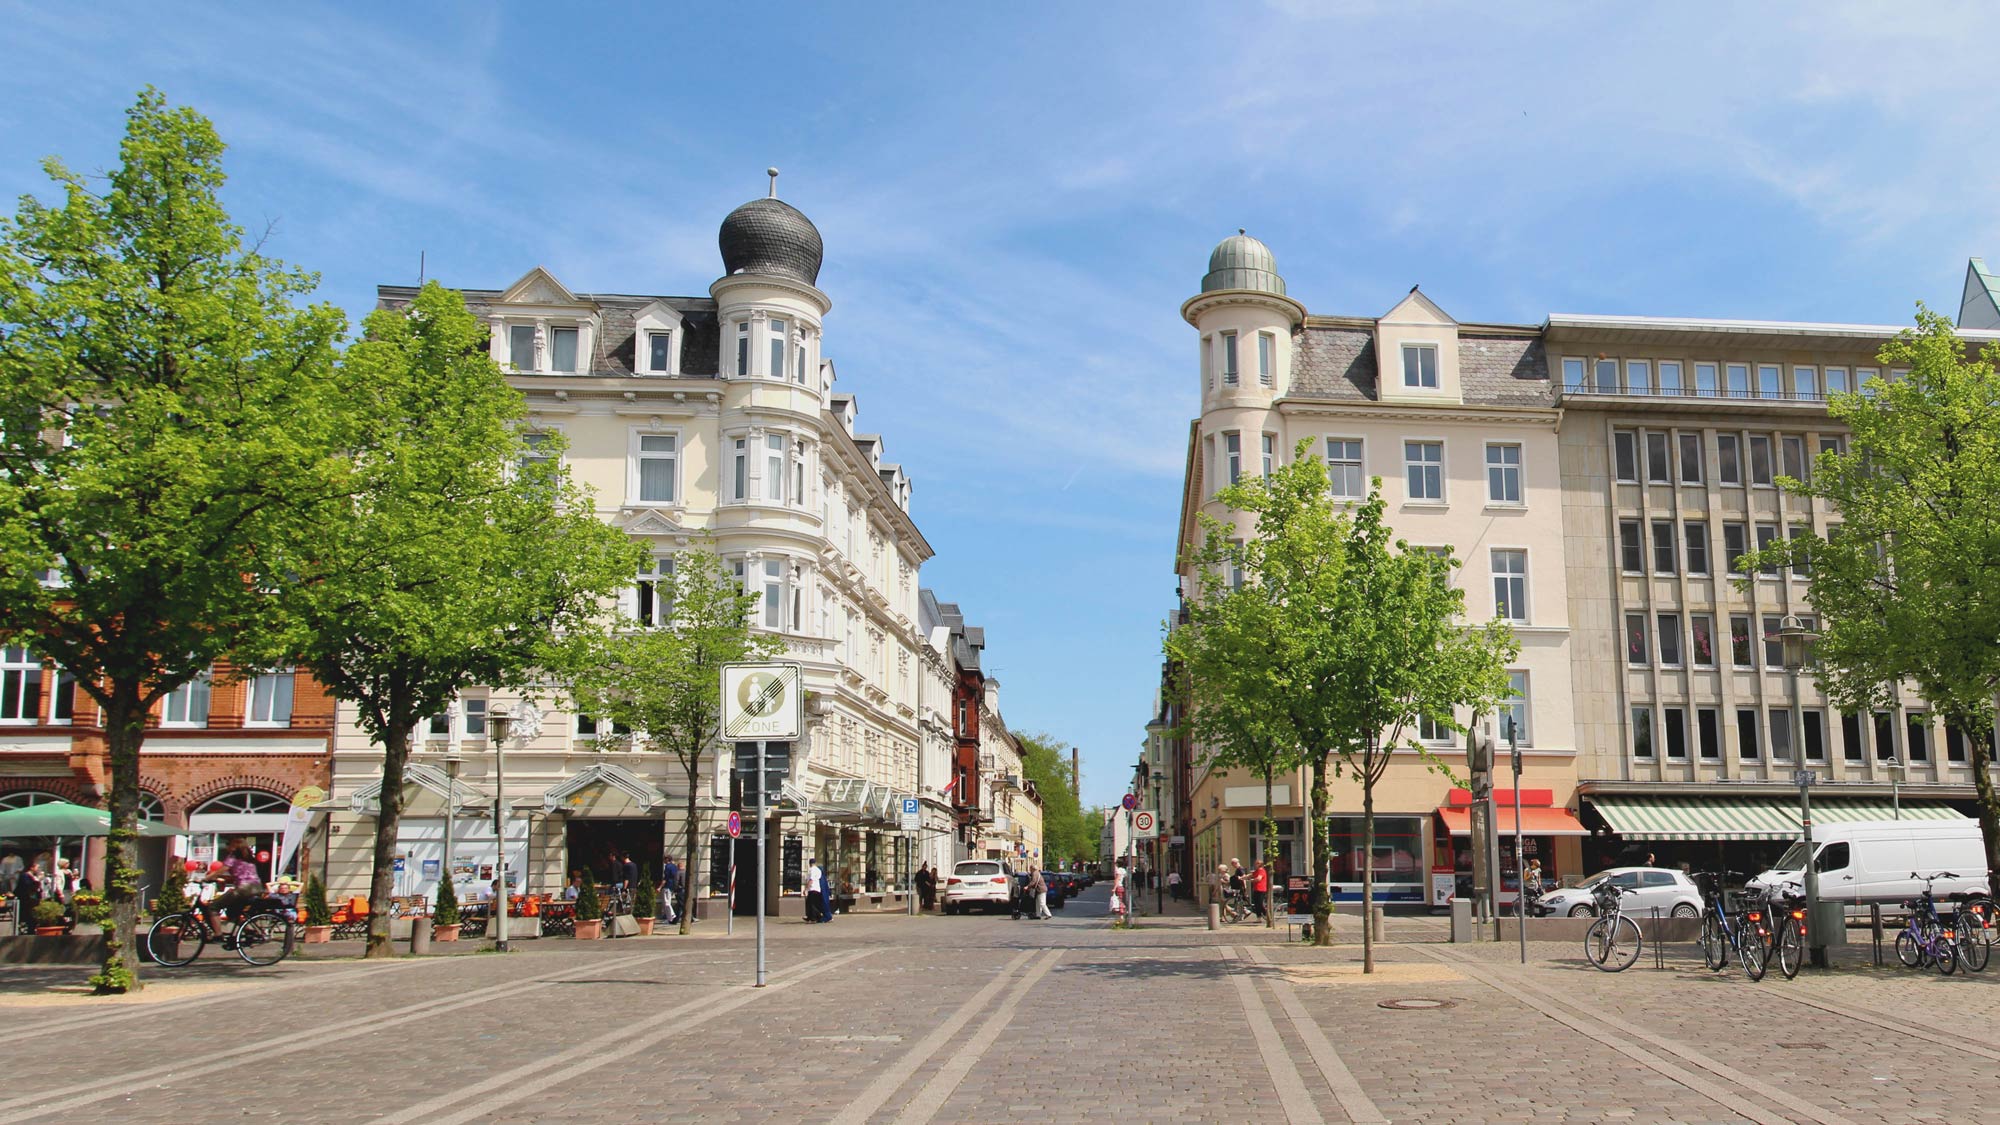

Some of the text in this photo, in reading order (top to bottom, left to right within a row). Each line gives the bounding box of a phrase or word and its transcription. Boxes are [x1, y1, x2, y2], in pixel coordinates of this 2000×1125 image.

[743, 721, 780, 732] ZONE
[906, 800, 915, 811] P
[1139, 817, 1150, 826] 30
